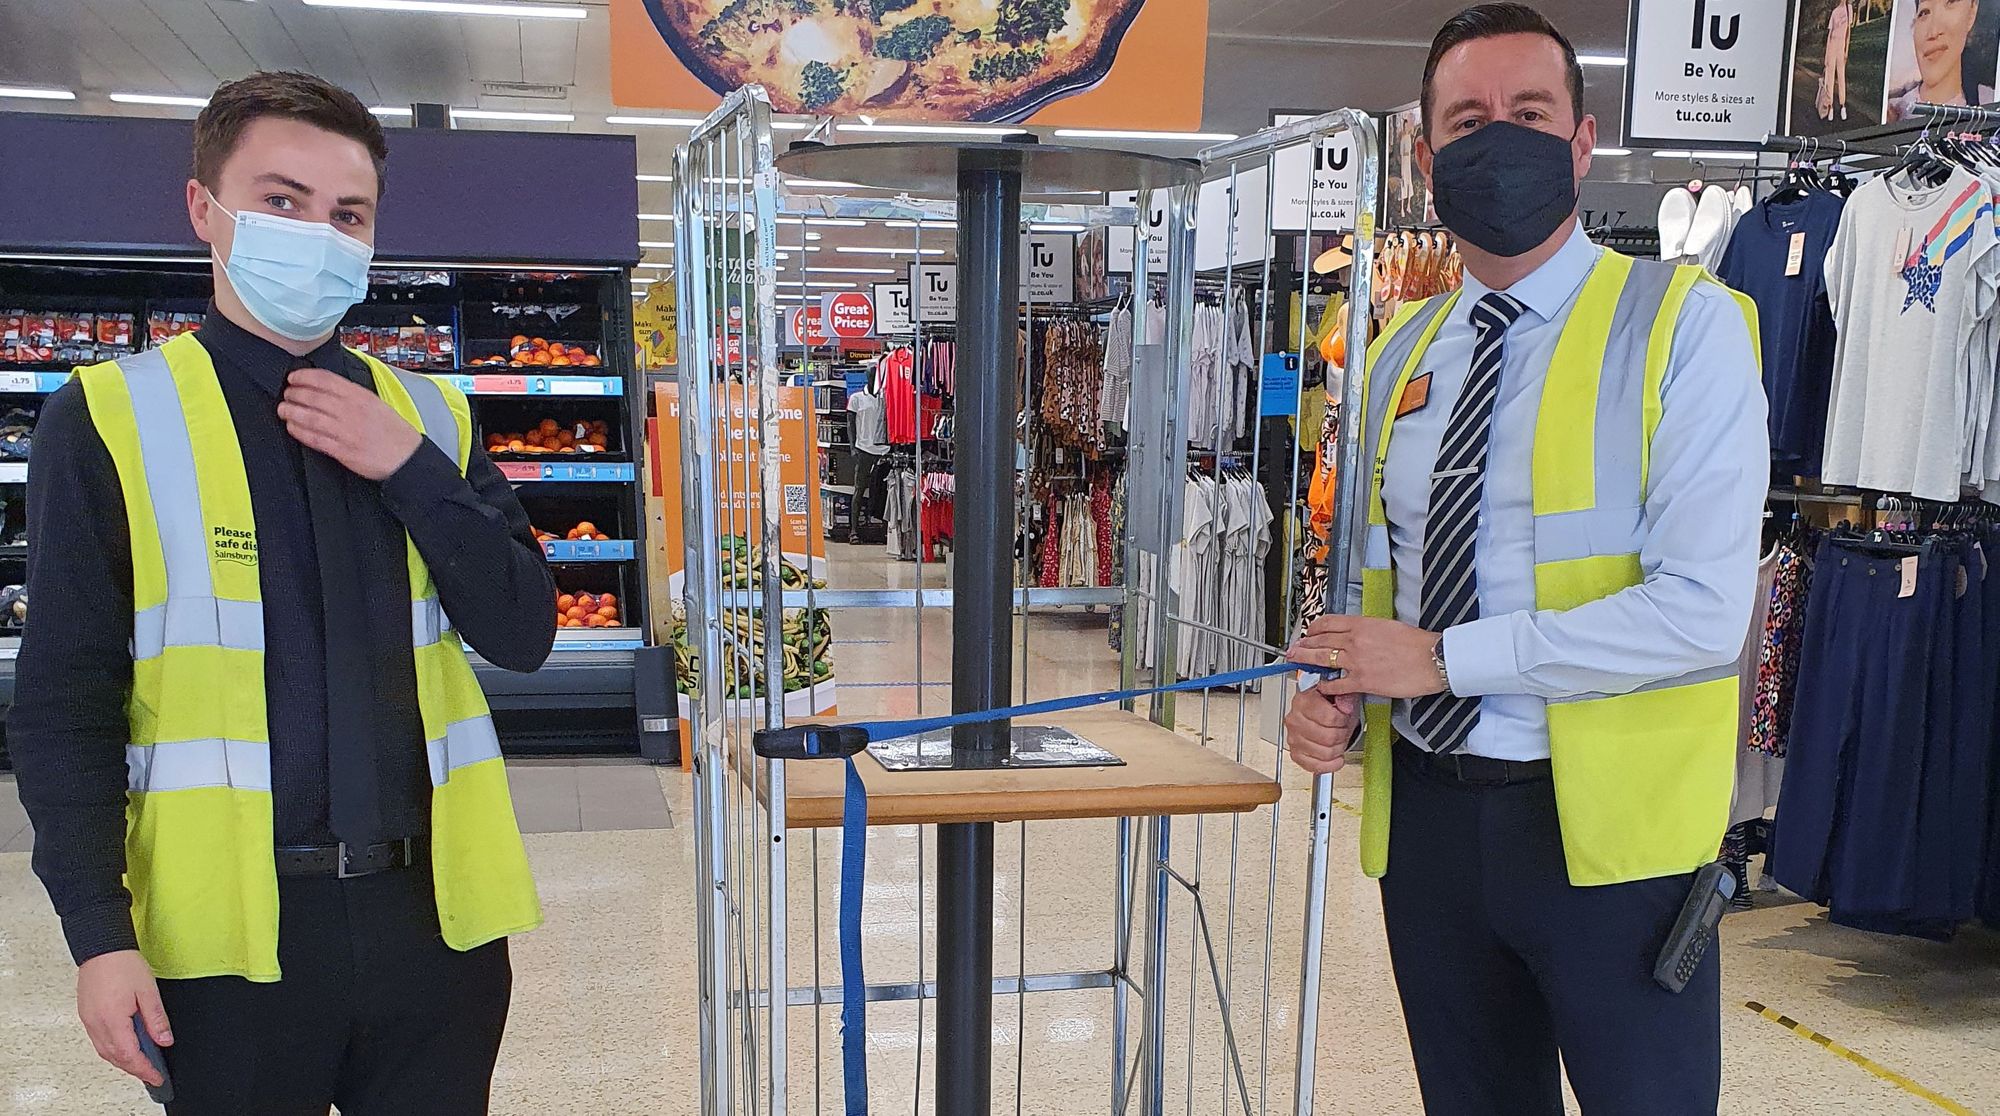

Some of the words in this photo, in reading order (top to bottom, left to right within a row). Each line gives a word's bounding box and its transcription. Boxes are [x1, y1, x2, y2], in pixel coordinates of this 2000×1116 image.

[1684, 62, 1704, 77] Be
[1708, 64, 1736, 78] You
[1654, 91, 1679, 102] More
[1682, 92, 1708, 104] styles
[1712, 93, 1718, 103] &
[1721, 93, 1743, 104] sizes
[1745, 95, 1755, 104] at
[1676, 109, 1732, 123] tu.co.uk
[1313, 180, 1324, 188] Be
[1328, 180, 1348, 189] You
[1830, 176, 1839, 186] Tu
[1311, 209, 1345, 218] u.co.uk
[1031, 243, 1053, 267] Tu
[925, 272, 948, 292] Tu
[889, 291, 909, 308] Tu
[834, 303, 869, 315] Great
[798, 315, 821, 326] Grea
[834, 316, 869, 328] Prices
[214, 526, 252, 538] Please
[1874, 532, 1882, 542] Tu
[215, 539, 239, 549] safe
